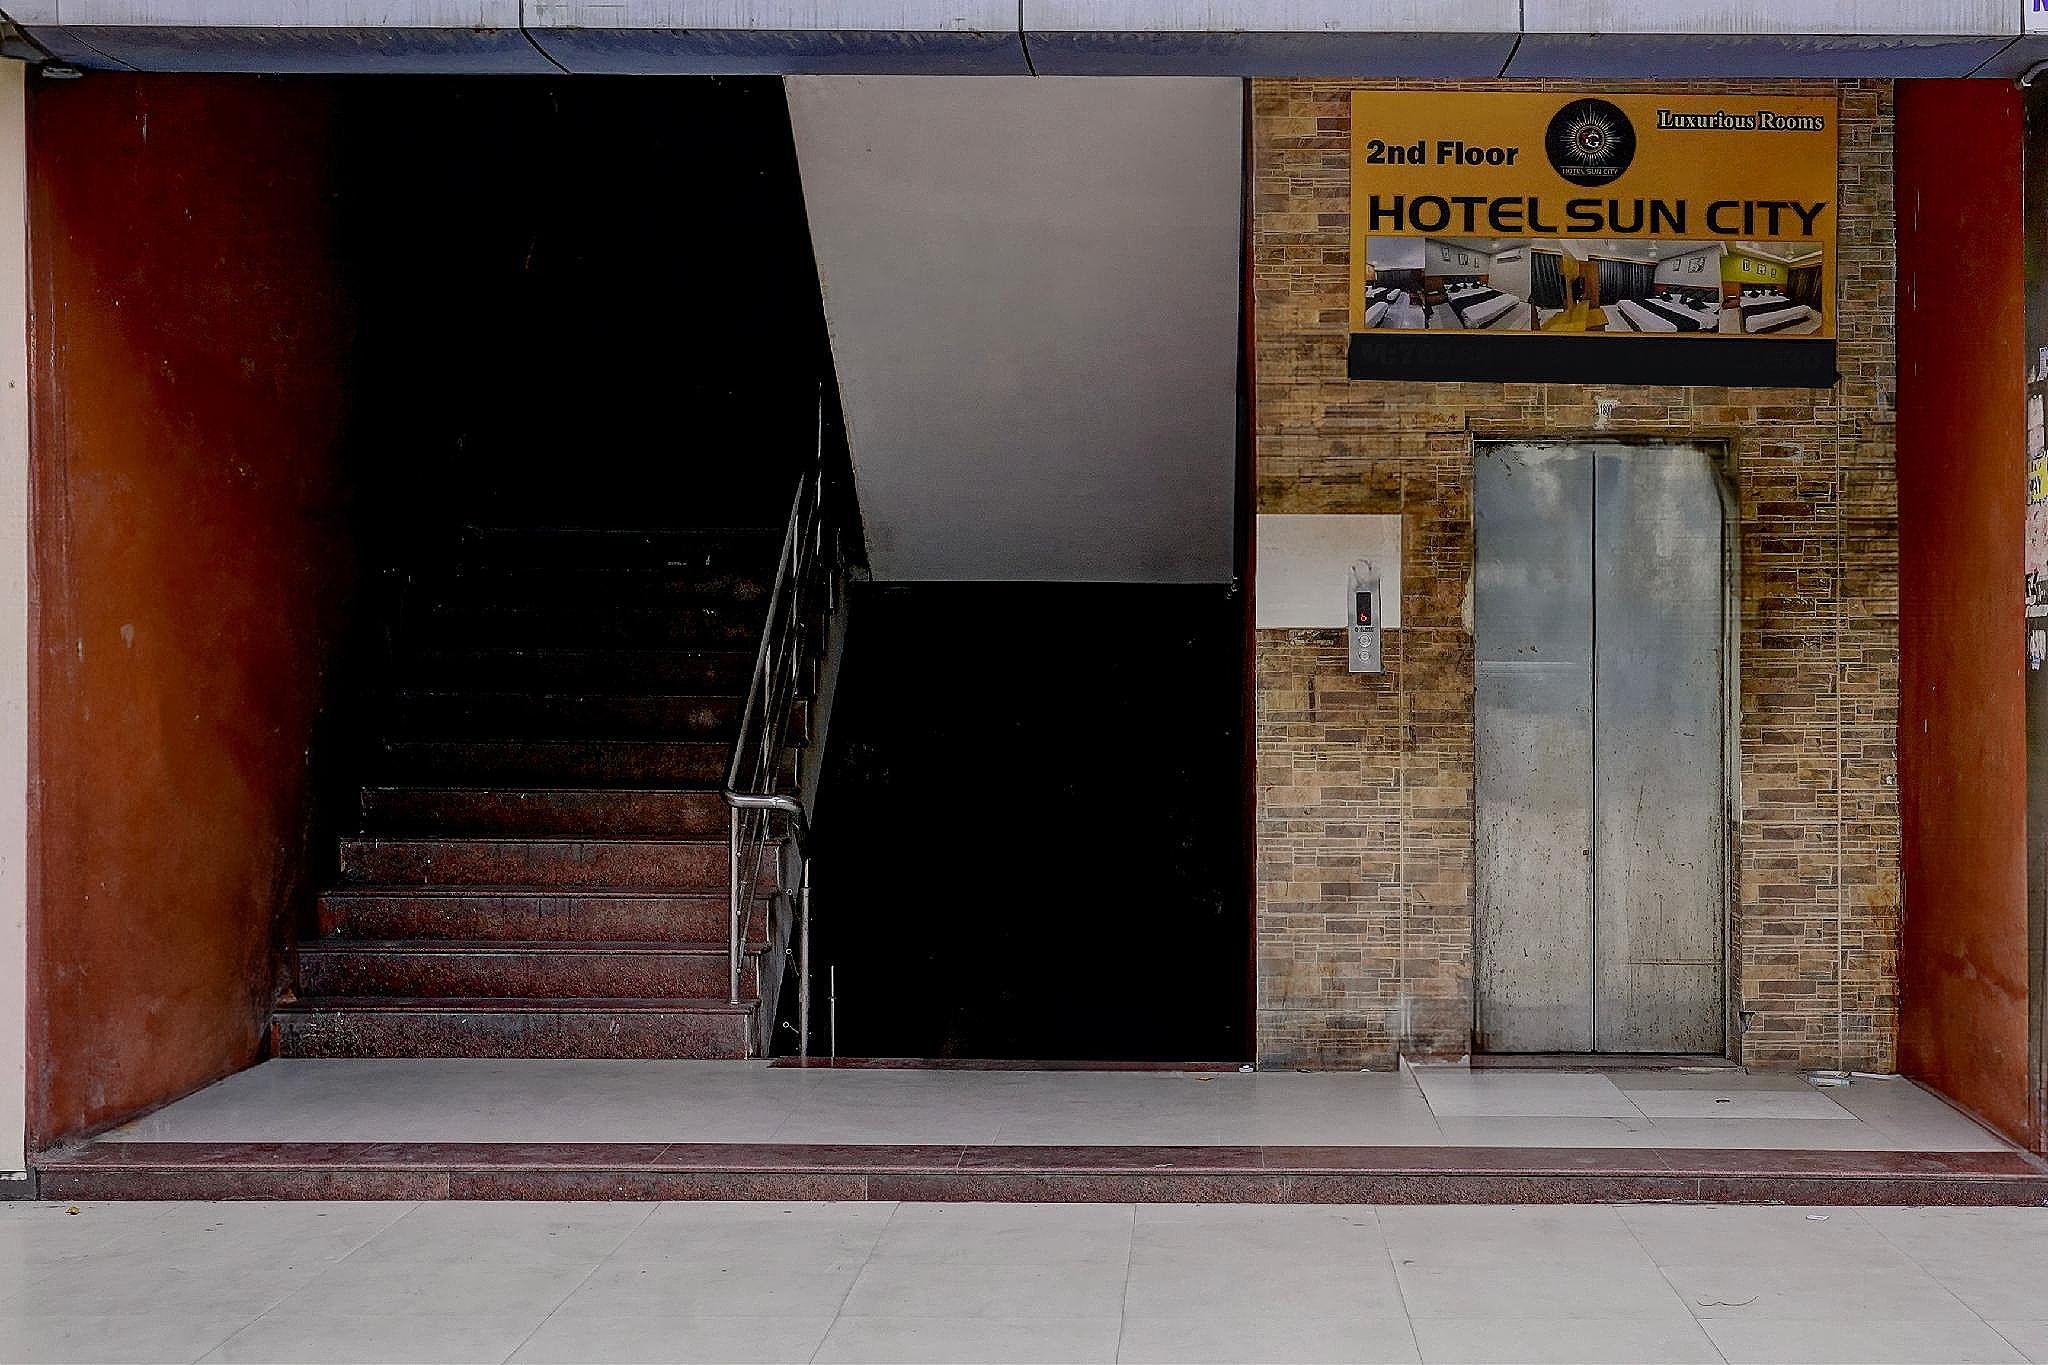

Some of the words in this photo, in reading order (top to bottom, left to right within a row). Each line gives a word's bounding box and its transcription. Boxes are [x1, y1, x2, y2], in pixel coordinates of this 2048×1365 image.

[1657, 110, 1755, 129] Luxurious
[1758, 112, 1825, 131] Rooms
[1366, 139, 1426, 165] 2nd
[1436, 140, 1519, 166] Floor
[1369, 195, 1558, 233] HOTEL
[1565, 198, 1686, 234] SUN
[1706, 200, 1826, 236] CITY
